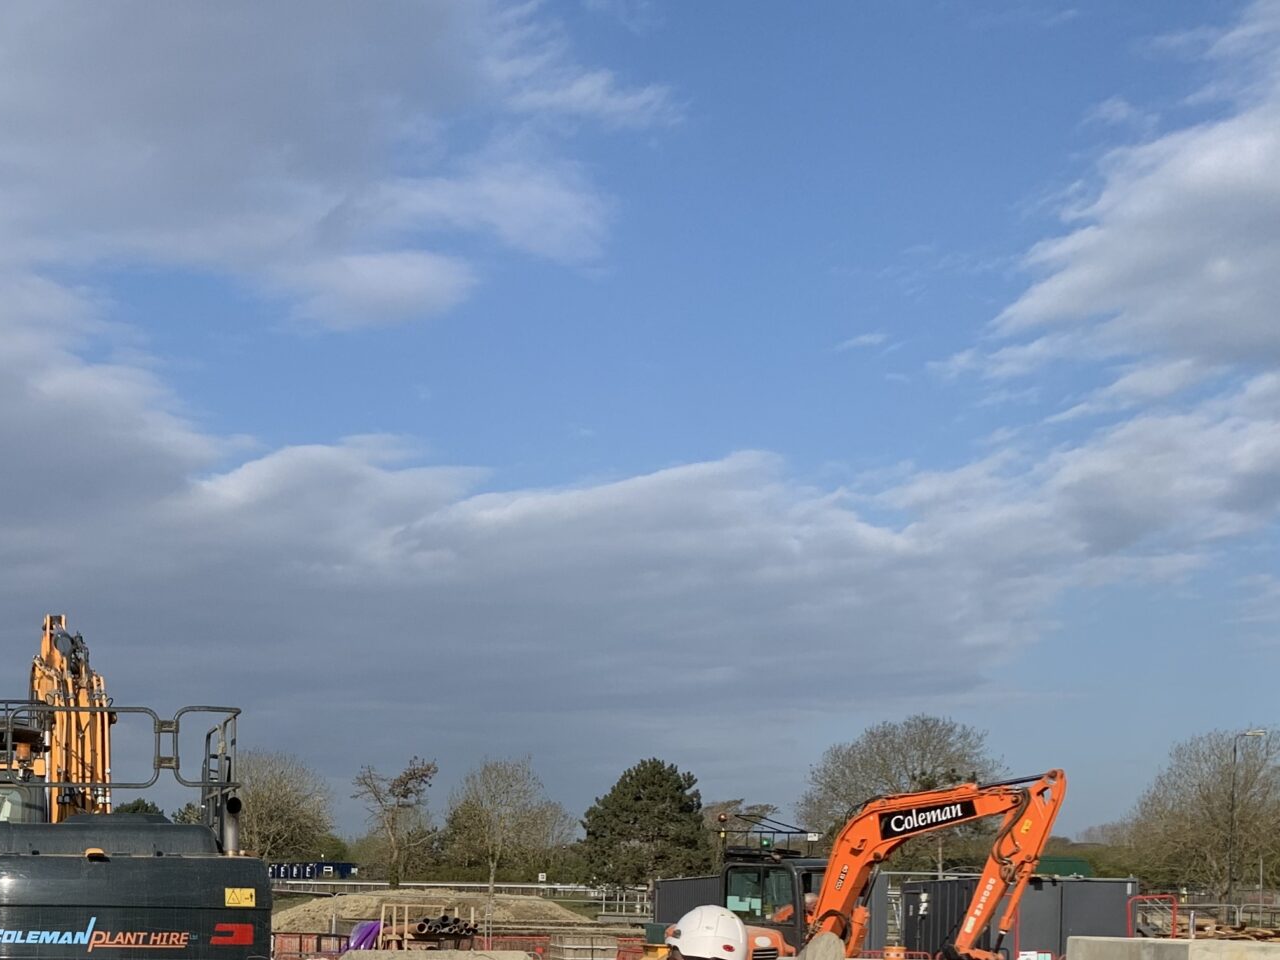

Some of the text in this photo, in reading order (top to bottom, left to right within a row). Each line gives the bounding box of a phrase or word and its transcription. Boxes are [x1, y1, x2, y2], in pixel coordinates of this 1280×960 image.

[890, 803, 963, 832] Coleman
[87, 931, 147, 952] PLANT
[150, 932, 189, 945] HIRE
